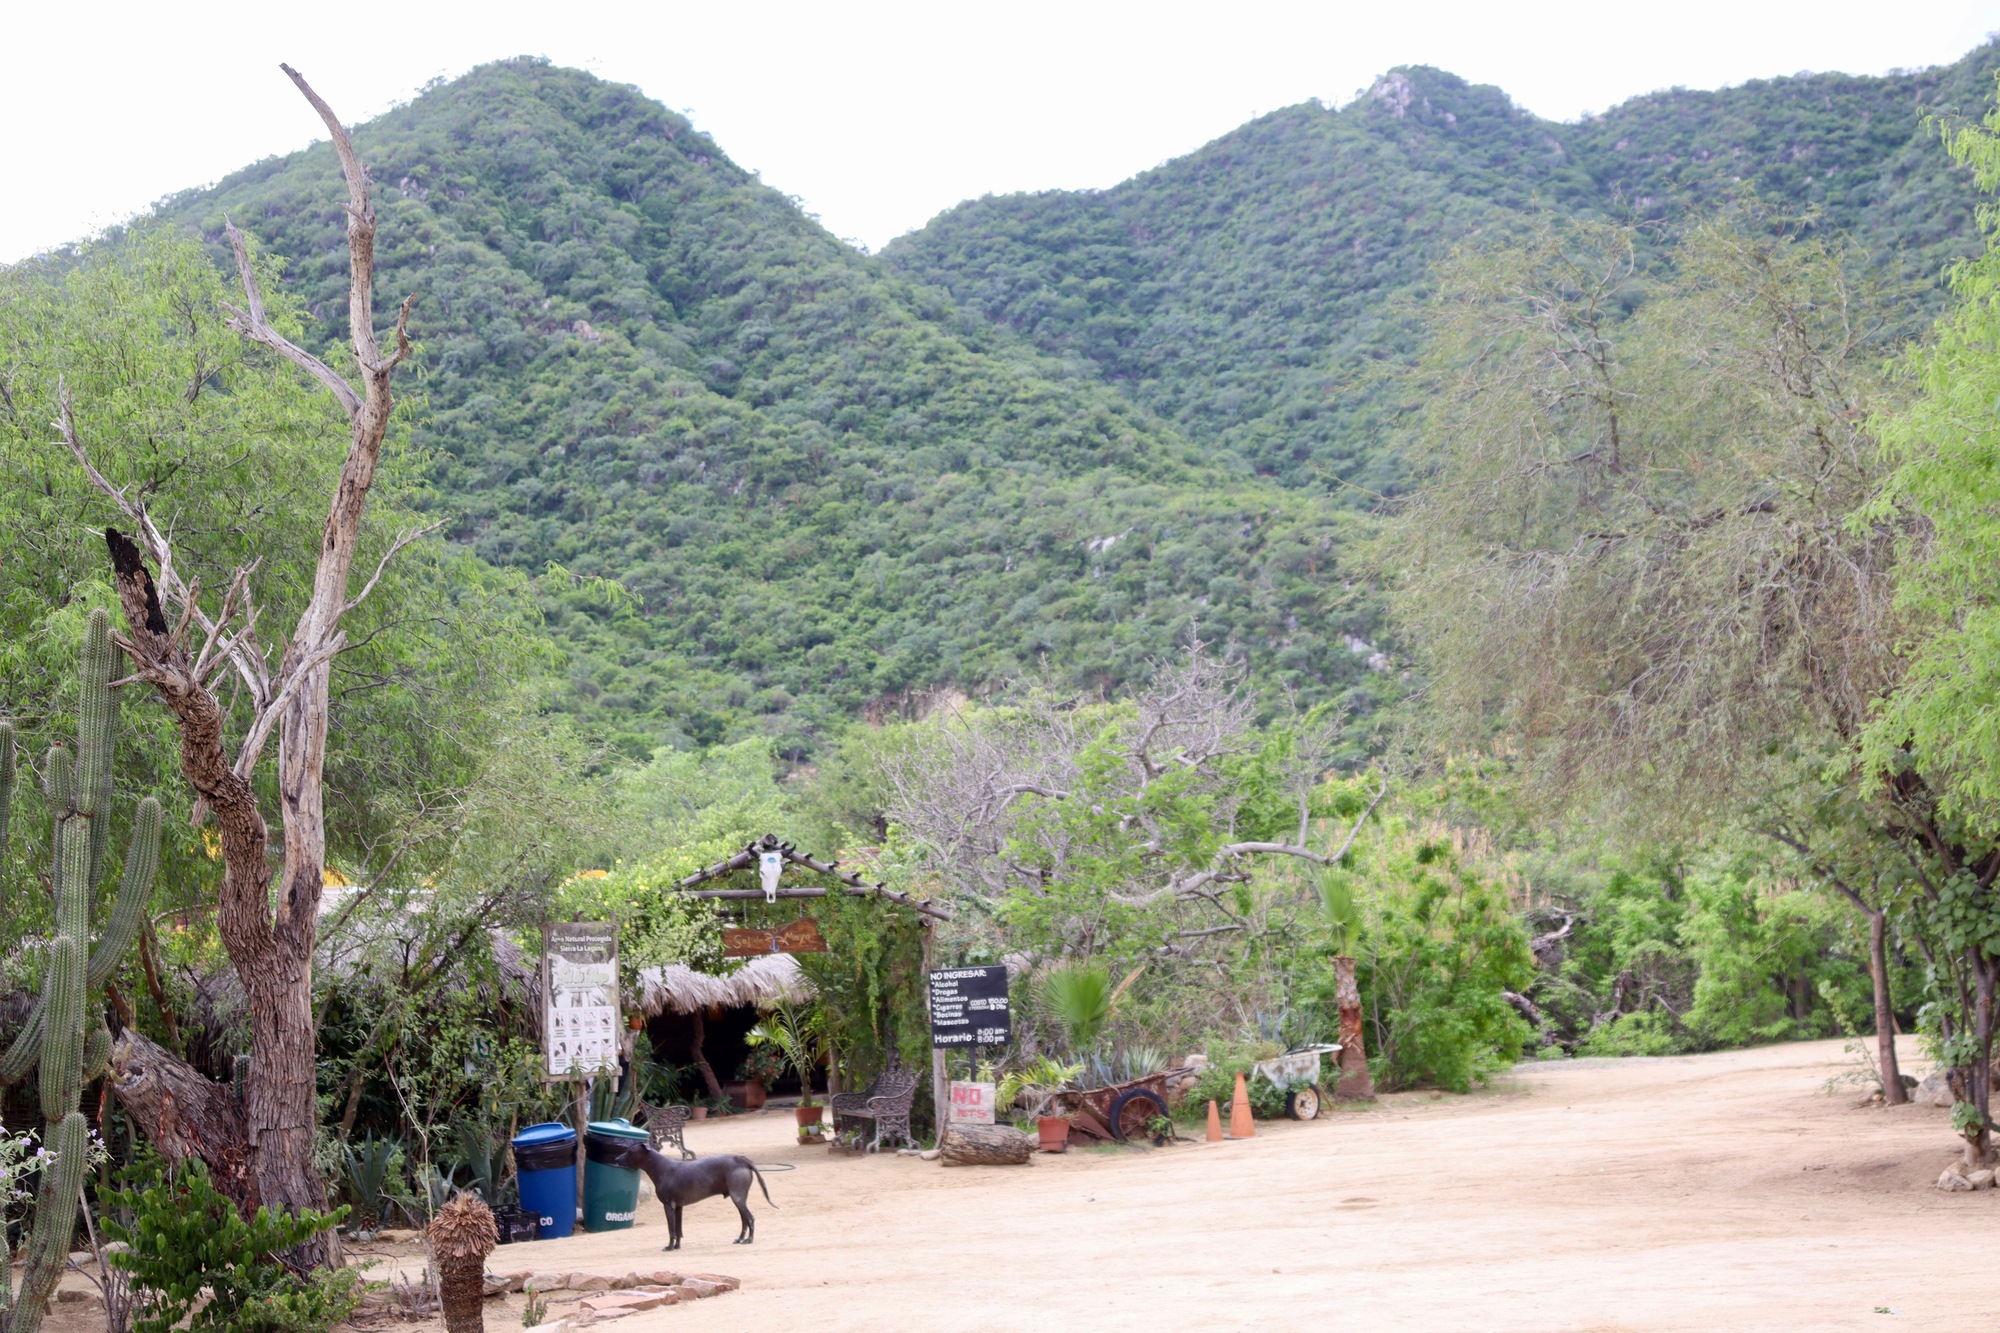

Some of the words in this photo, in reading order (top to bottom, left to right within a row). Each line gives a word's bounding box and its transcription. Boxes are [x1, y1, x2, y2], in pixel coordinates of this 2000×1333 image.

[586, 935, 612, 943] Protegida
[733, 934, 751, 949] Sol
[785, 931, 811, 945] Mayo
[930, 972, 943, 980] NO
[944, 969, 987, 979] INGRESAR:
[934, 1033, 976, 1043] Horario:
[995, 1036, 1005, 1045] pm
[953, 1087, 981, 1105] NO
[540, 1216, 553, 1226] CO
[605, 1211, 636, 1221] ORGAN
